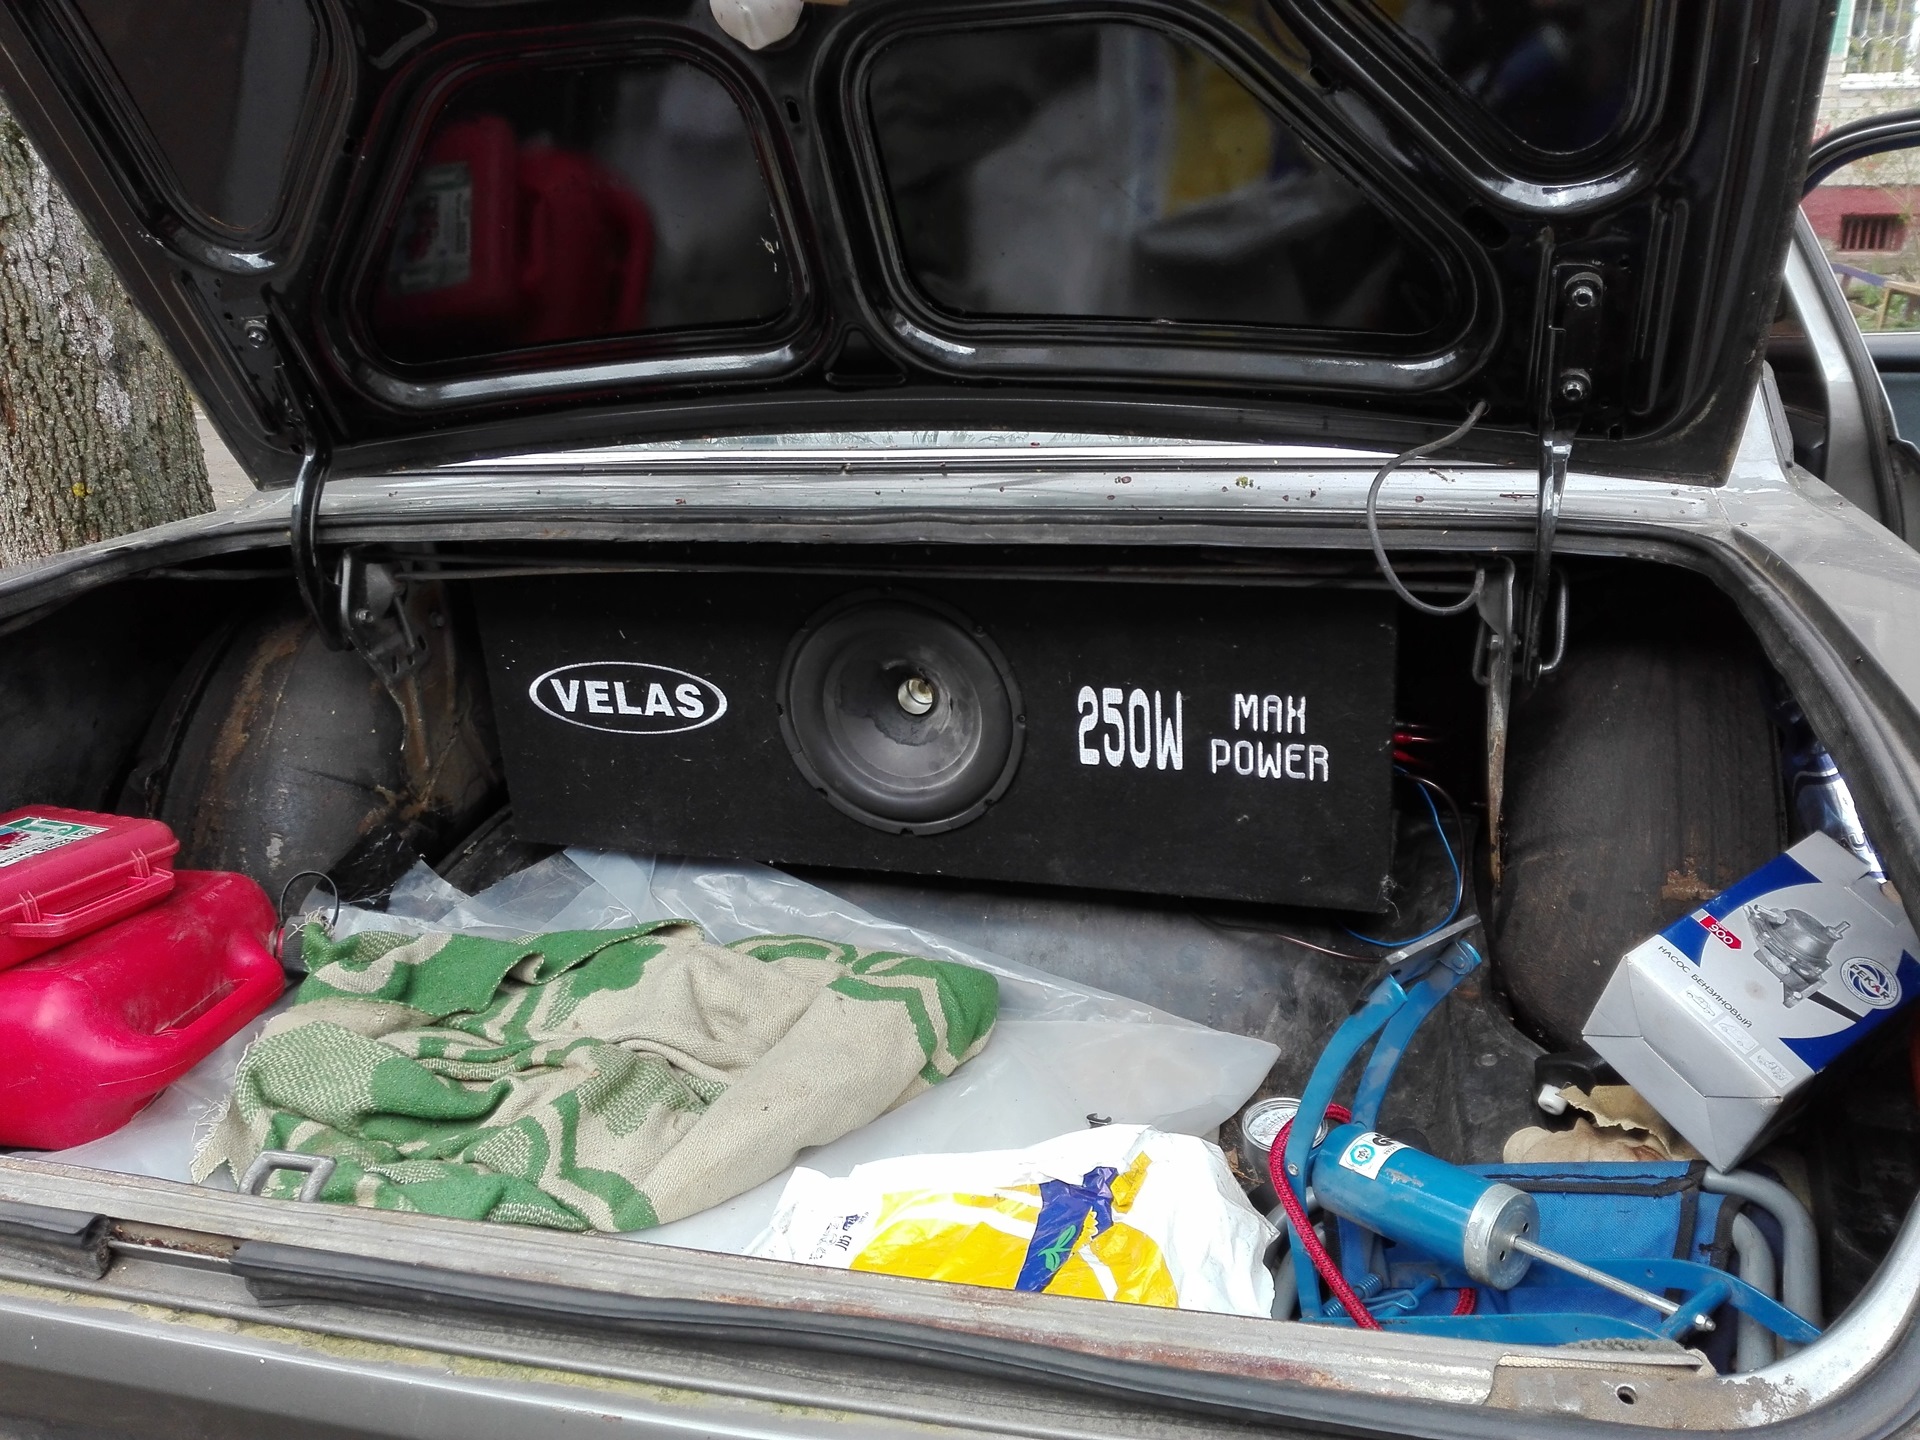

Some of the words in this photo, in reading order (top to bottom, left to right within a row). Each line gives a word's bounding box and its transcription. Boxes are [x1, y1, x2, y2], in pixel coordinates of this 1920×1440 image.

[550, 679, 705, 719] VELAS
[1234, 693, 1306, 735] MAX
[1077, 685, 1184, 771] 250W
[1211, 738, 1329, 782] POWER
[1708, 924, 1734, 945] 900
[1658, 945, 1691, 974] НАСОС
[1691, 973, 1753, 1029] БЕНЗИНОВЫЙ
[1849, 963, 1891, 1000] PEKAR
